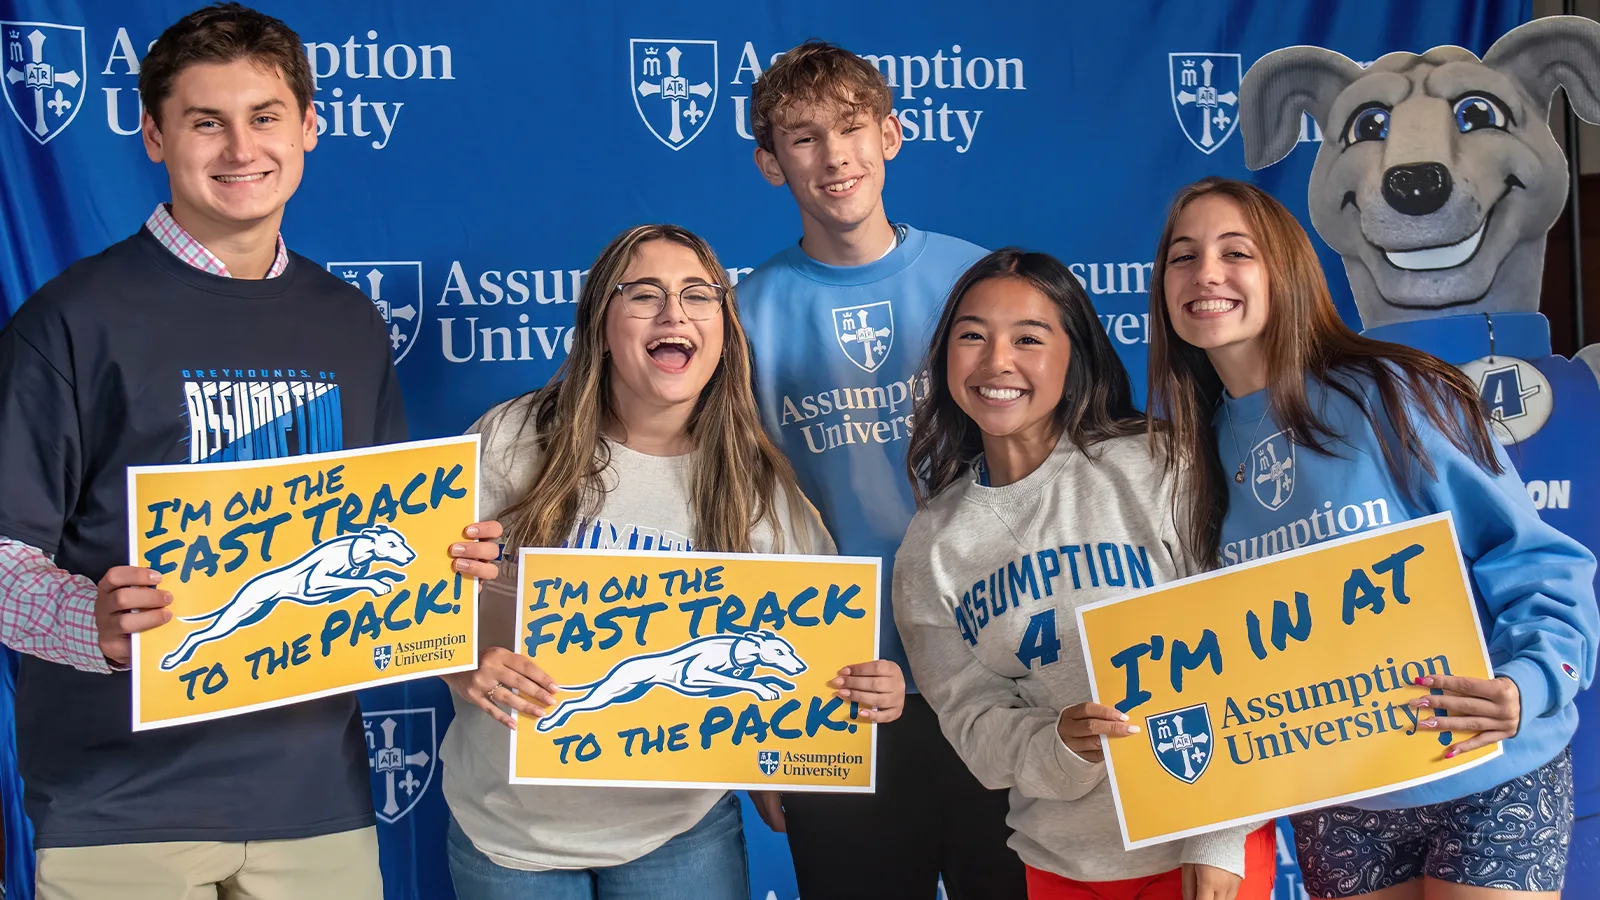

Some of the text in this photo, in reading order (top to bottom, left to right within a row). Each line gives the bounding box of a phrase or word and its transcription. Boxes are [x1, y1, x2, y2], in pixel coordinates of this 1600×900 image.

[730, 41, 1027, 100] Amption
[319, 371, 336, 380] OF
[781, 369, 931, 427] Assumpti
[184, 381, 343, 464] ASSUMPTION
[800, 413, 915, 454] Univers
[144, 464, 467, 584] FAST TRACK
[145, 464, 345, 539] I'M ON THE
[1219, 497, 1391, 568] sumption
[525, 583, 866, 657] FAST TRACK
[529, 566, 725, 612] I'M ON THE
[954, 542, 1154, 647] ASSUMPTION
[179, 571, 462, 701] TO THE PACK!
[395, 633, 466, 654] Assumption
[395, 648, 456, 667] University
[1110, 543, 1425, 714] I'M IN AT
[1221, 654, 1454, 729] Assumption
[553, 696, 859, 764] TO THE PACK!
[783, 751, 863, 766] Assumption
[783, 764, 851, 780] University
